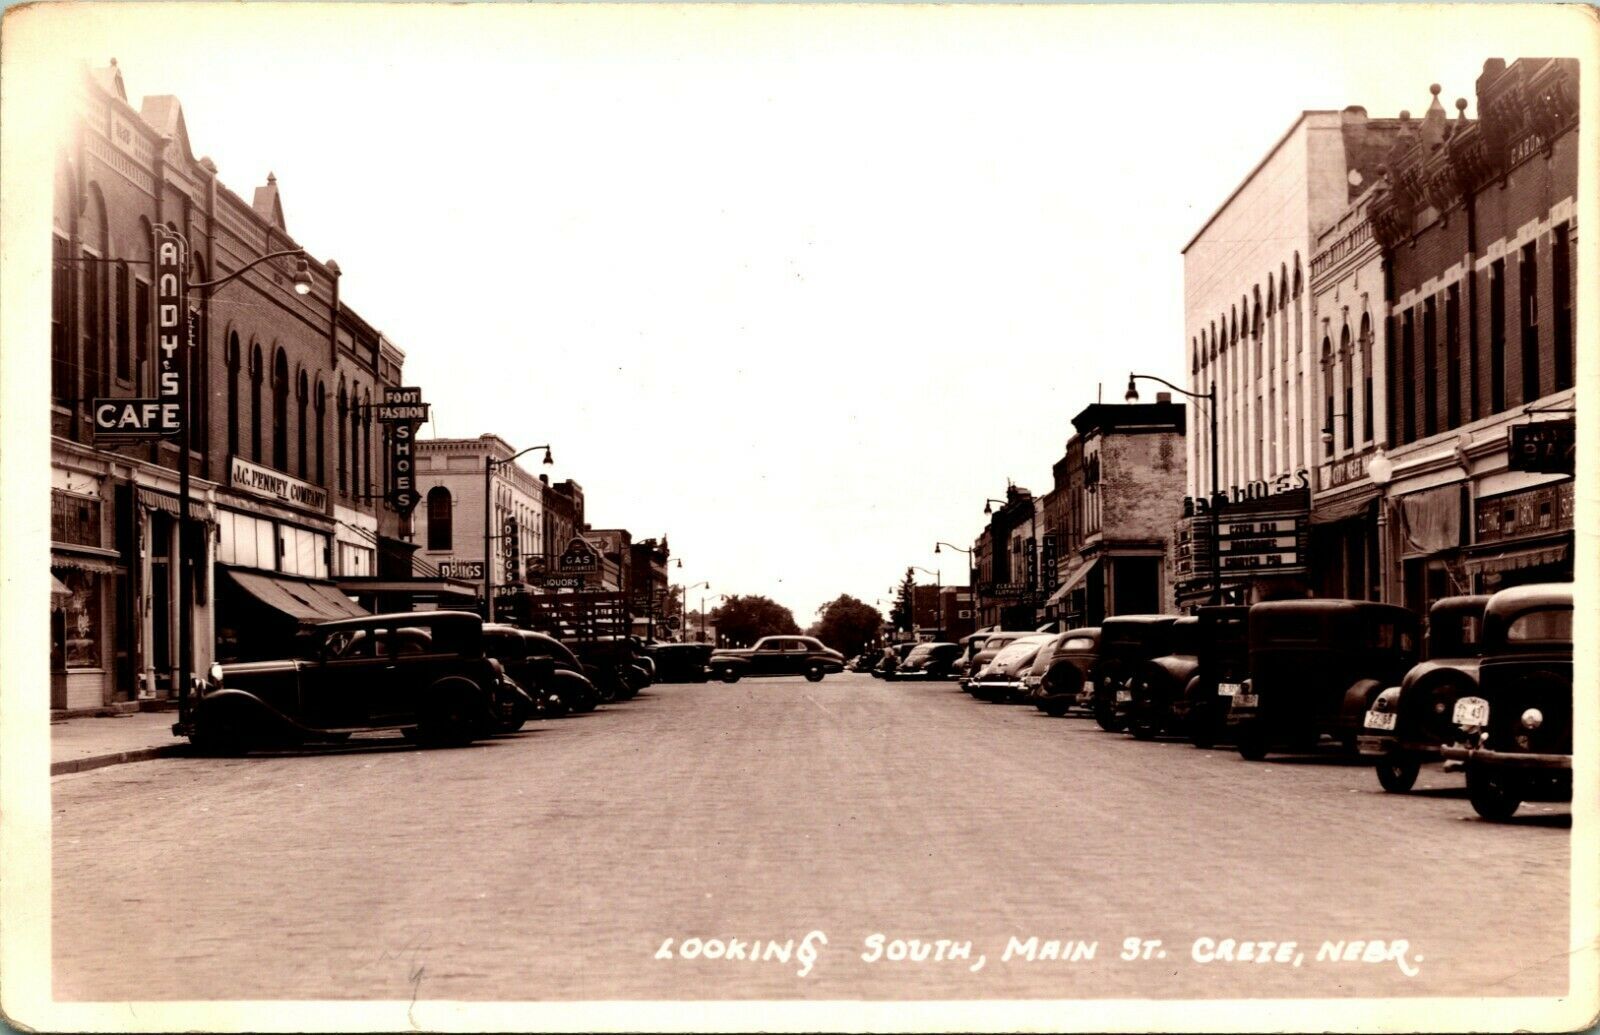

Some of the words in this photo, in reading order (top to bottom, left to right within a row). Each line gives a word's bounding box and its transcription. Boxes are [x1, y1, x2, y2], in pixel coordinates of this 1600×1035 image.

[160, 241, 180, 396] ANDY'S
[386, 392, 419, 404] FOOT
[96, 403, 181, 430] CAFE
[380, 407, 425, 419] FASHION
[396, 425, 411, 507] SHOES
[251, 469, 289, 497] PENNEY
[290, 484, 327, 510] COMPANY
[504, 524, 514, 582] DRUGS
[565, 555, 591, 565] GAS
[441, 565, 482, 578] DRUGS
[543, 578, 579, 587] IQUORS
